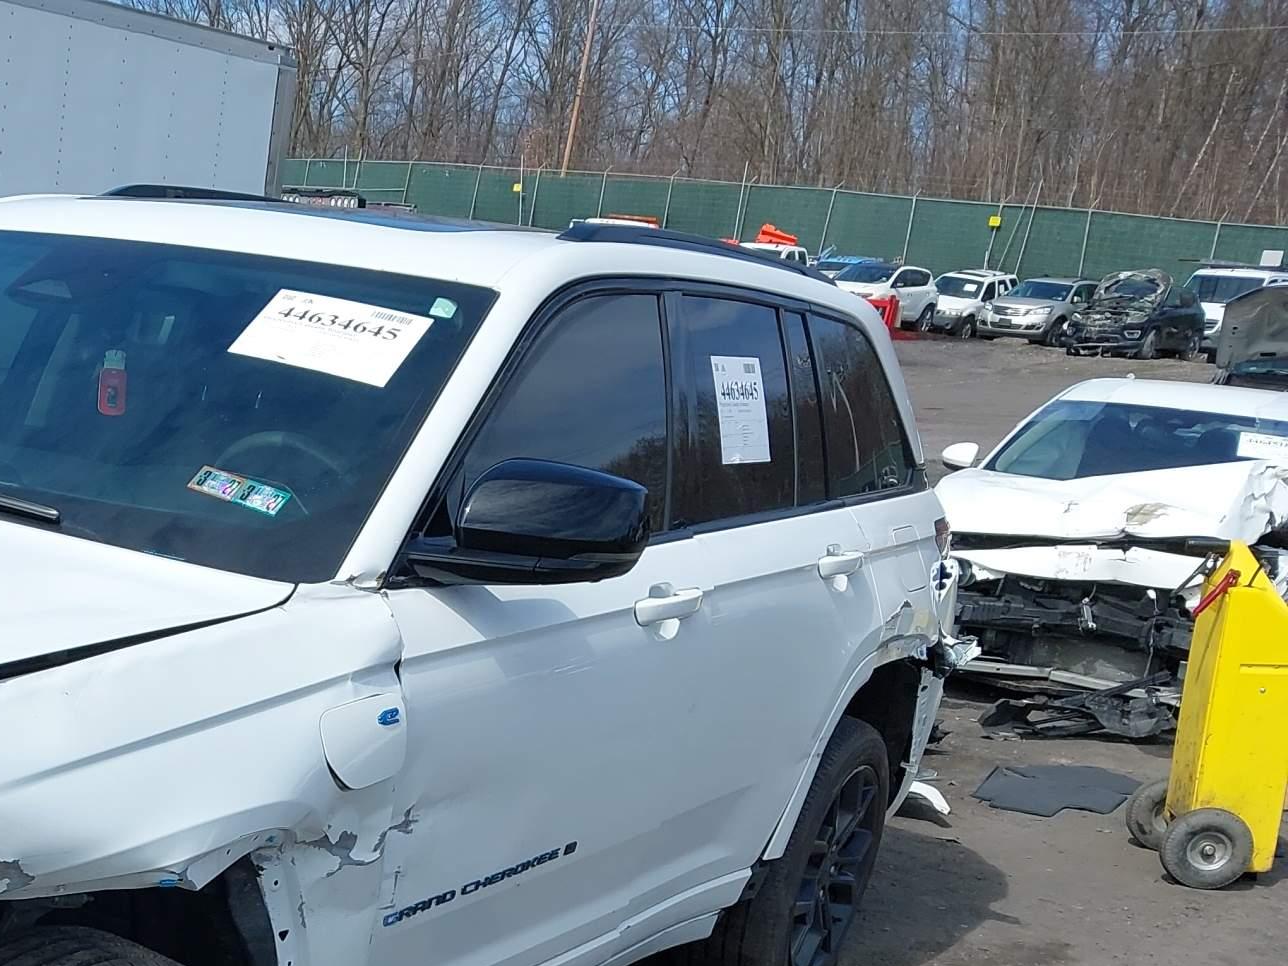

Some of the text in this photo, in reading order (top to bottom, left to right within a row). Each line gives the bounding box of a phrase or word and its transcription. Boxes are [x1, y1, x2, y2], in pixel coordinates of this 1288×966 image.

[278, 307, 401, 340] 44634645
[720, 382, 759, 401] 44634645
[383, 848, 561, 927] GRAND CHEROKEE
